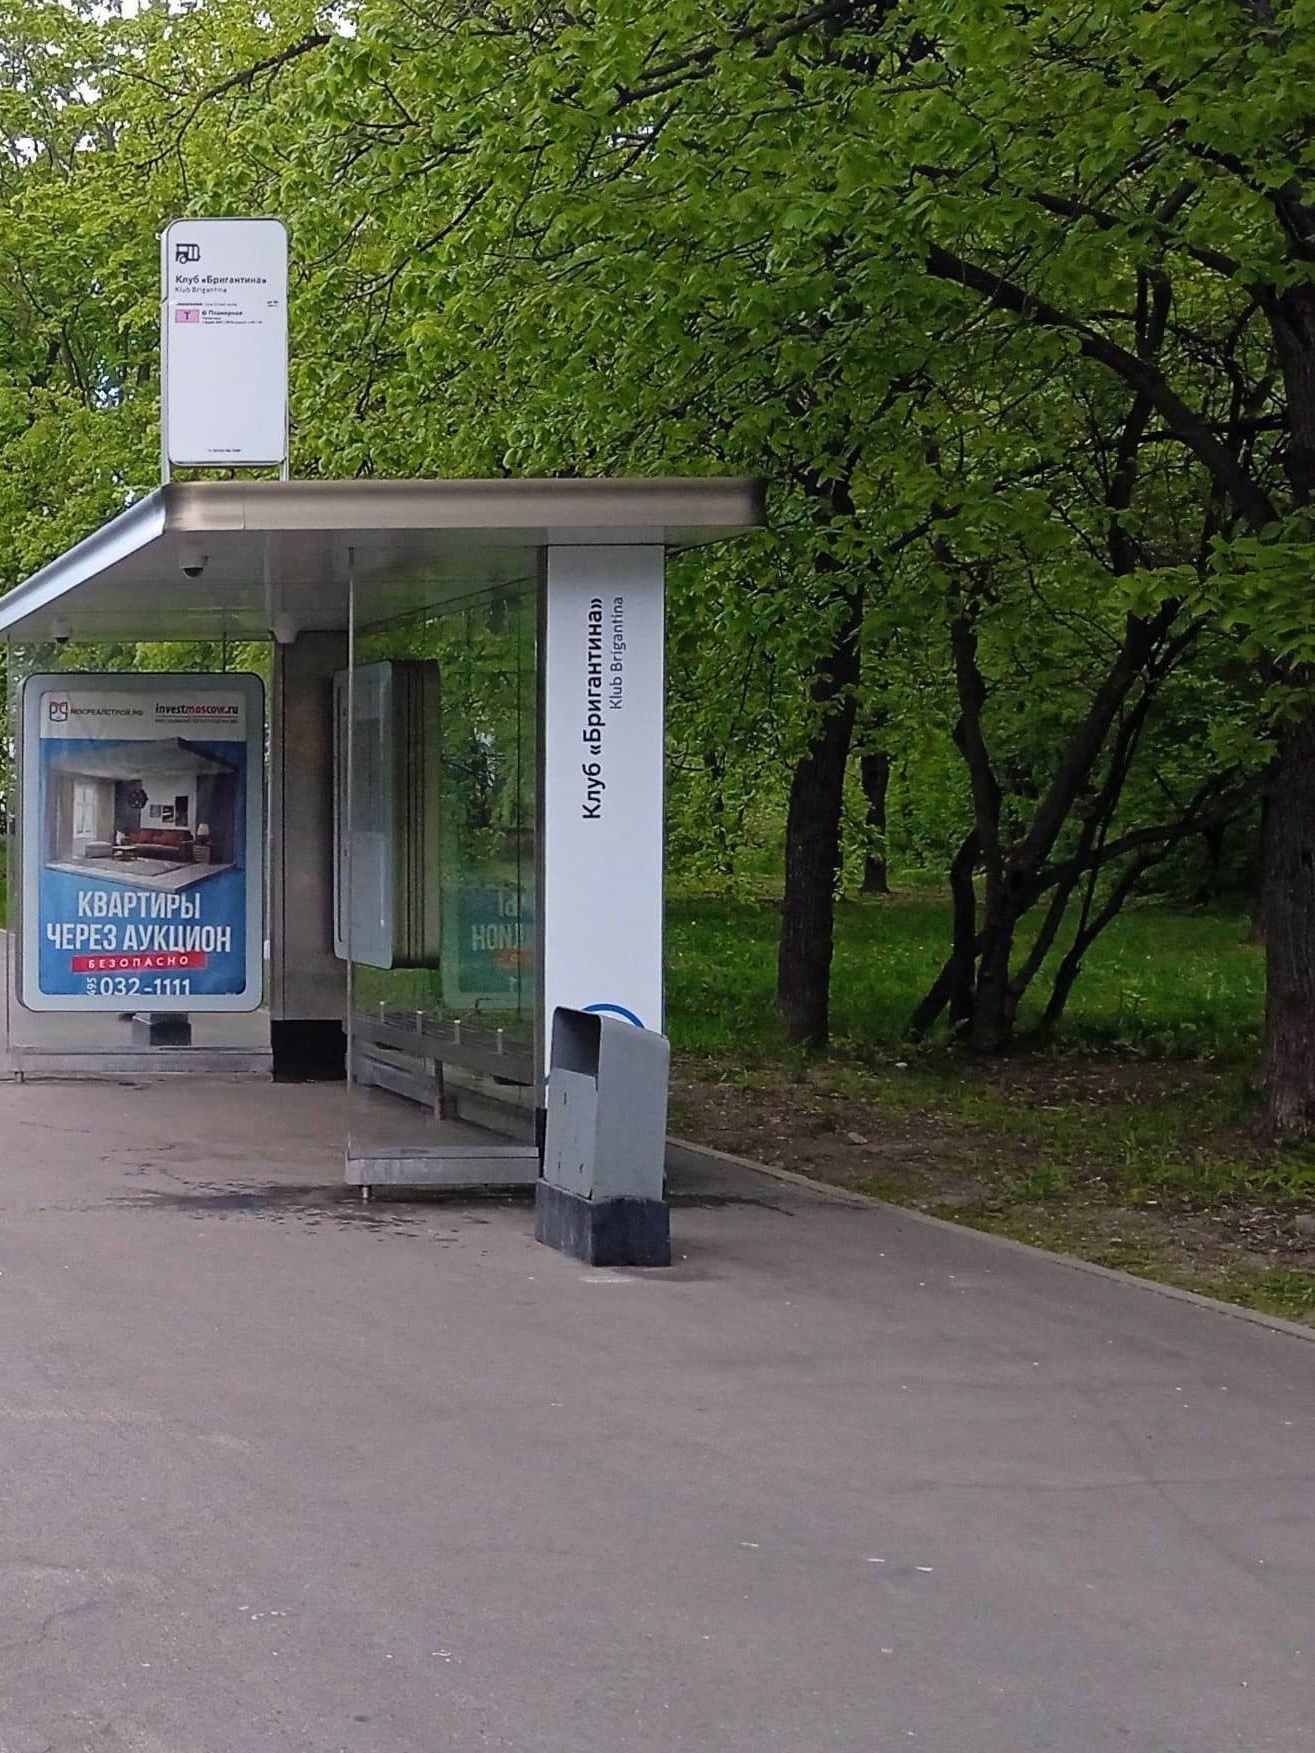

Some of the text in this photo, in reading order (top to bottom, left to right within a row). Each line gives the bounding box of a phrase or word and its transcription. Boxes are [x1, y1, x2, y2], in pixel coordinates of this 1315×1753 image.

[175, 274, 267, 285] Клуб «Бригантина»
[610, 596, 626, 710] Klub Brigantina
[155, 703, 239, 714] investmoscow.ru
[582, 597, 606, 819] Клуб «Бригантина»
[78, 890, 201, 919] КВАРТИРЫ
[47, 922, 231, 953] ЧЕРЕЗ АУКЦИОН
[88, 955, 189, 969] БЕЗОПАСНО
[100, 976, 191, 996] 032-1111
